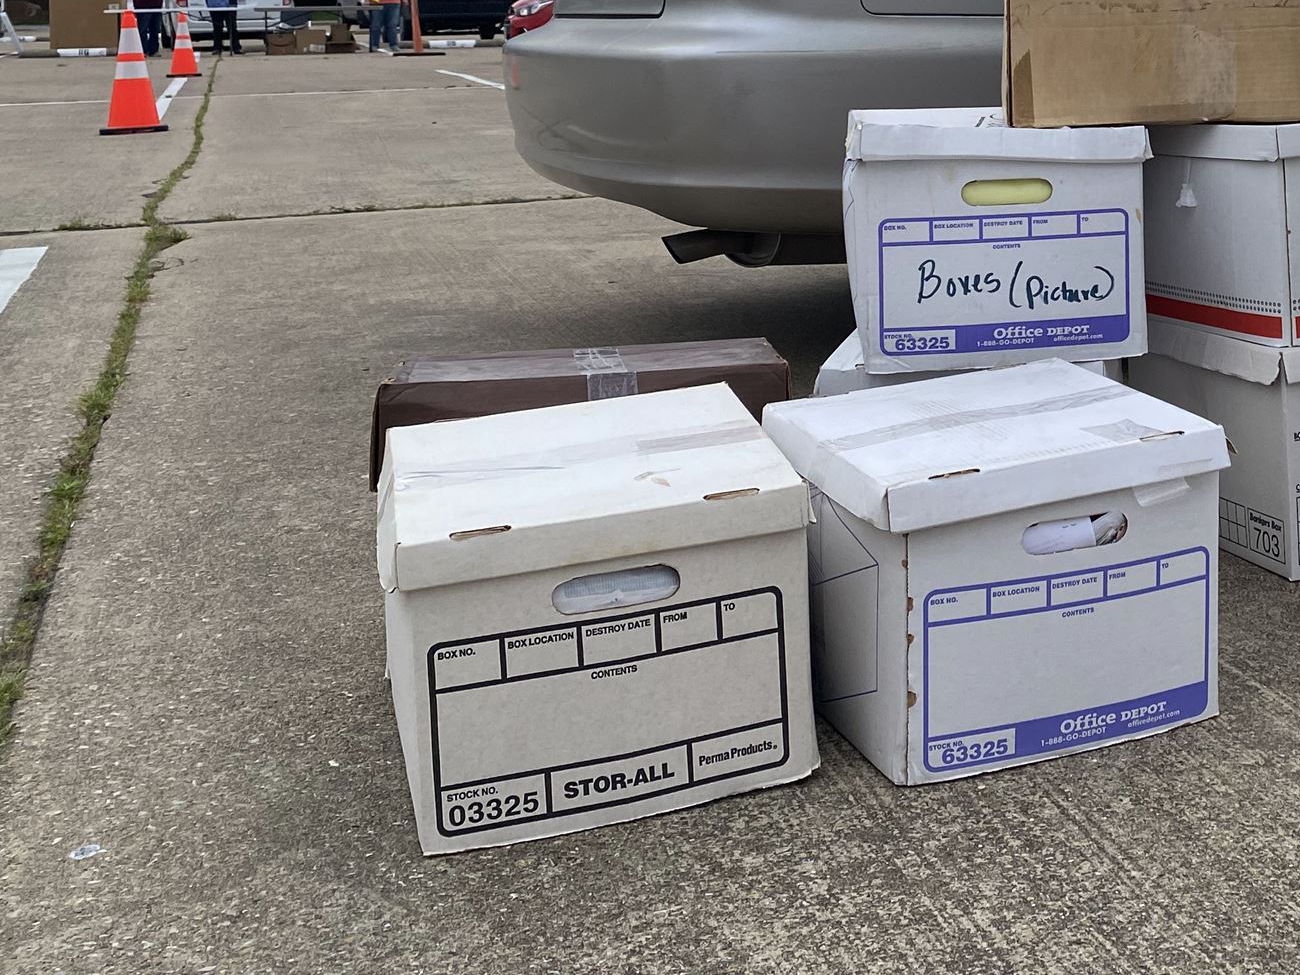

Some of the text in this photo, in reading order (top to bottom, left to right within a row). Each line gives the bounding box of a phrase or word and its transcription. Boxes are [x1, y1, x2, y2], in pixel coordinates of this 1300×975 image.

[994, 325, 1090, 339] Office DEPOT
[1053, 333, 1103, 342] officedepot.com
[895, 337, 950, 351] 63325
[1254, 527, 1279, 557] 703
[1052, 577, 1097, 589] DESTROY DATE
[1109, 572, 1126, 580] FROM
[992, 586, 1040, 598] BOX LOCATION
[723, 602, 735, 612] TO
[1062, 607, 1095, 618] CONTENTS
[663, 611, 688, 623] FROM
[585, 618, 651, 637] DESTROY DATE
[507, 631, 574, 650] BOX LOCATION
[437, 648, 476, 661] BOX NO.
[591, 664, 637, 680] CONTENTS
[1060, 701, 1167, 734] Office DEPOT
[1127, 709, 1180, 728] officedepot.com
[1041, 727, 1107, 747] 1-888-GO-DEPOT
[929, 742, 951, 751] STOCK
[942, 738, 1009, 765] 63325
[698, 751, 730, 767] Perma
[564, 762, 675, 799] STOR-ALL
[446, 786, 499, 802] STOCK NO.
[448, 791, 539, 826] 03325
